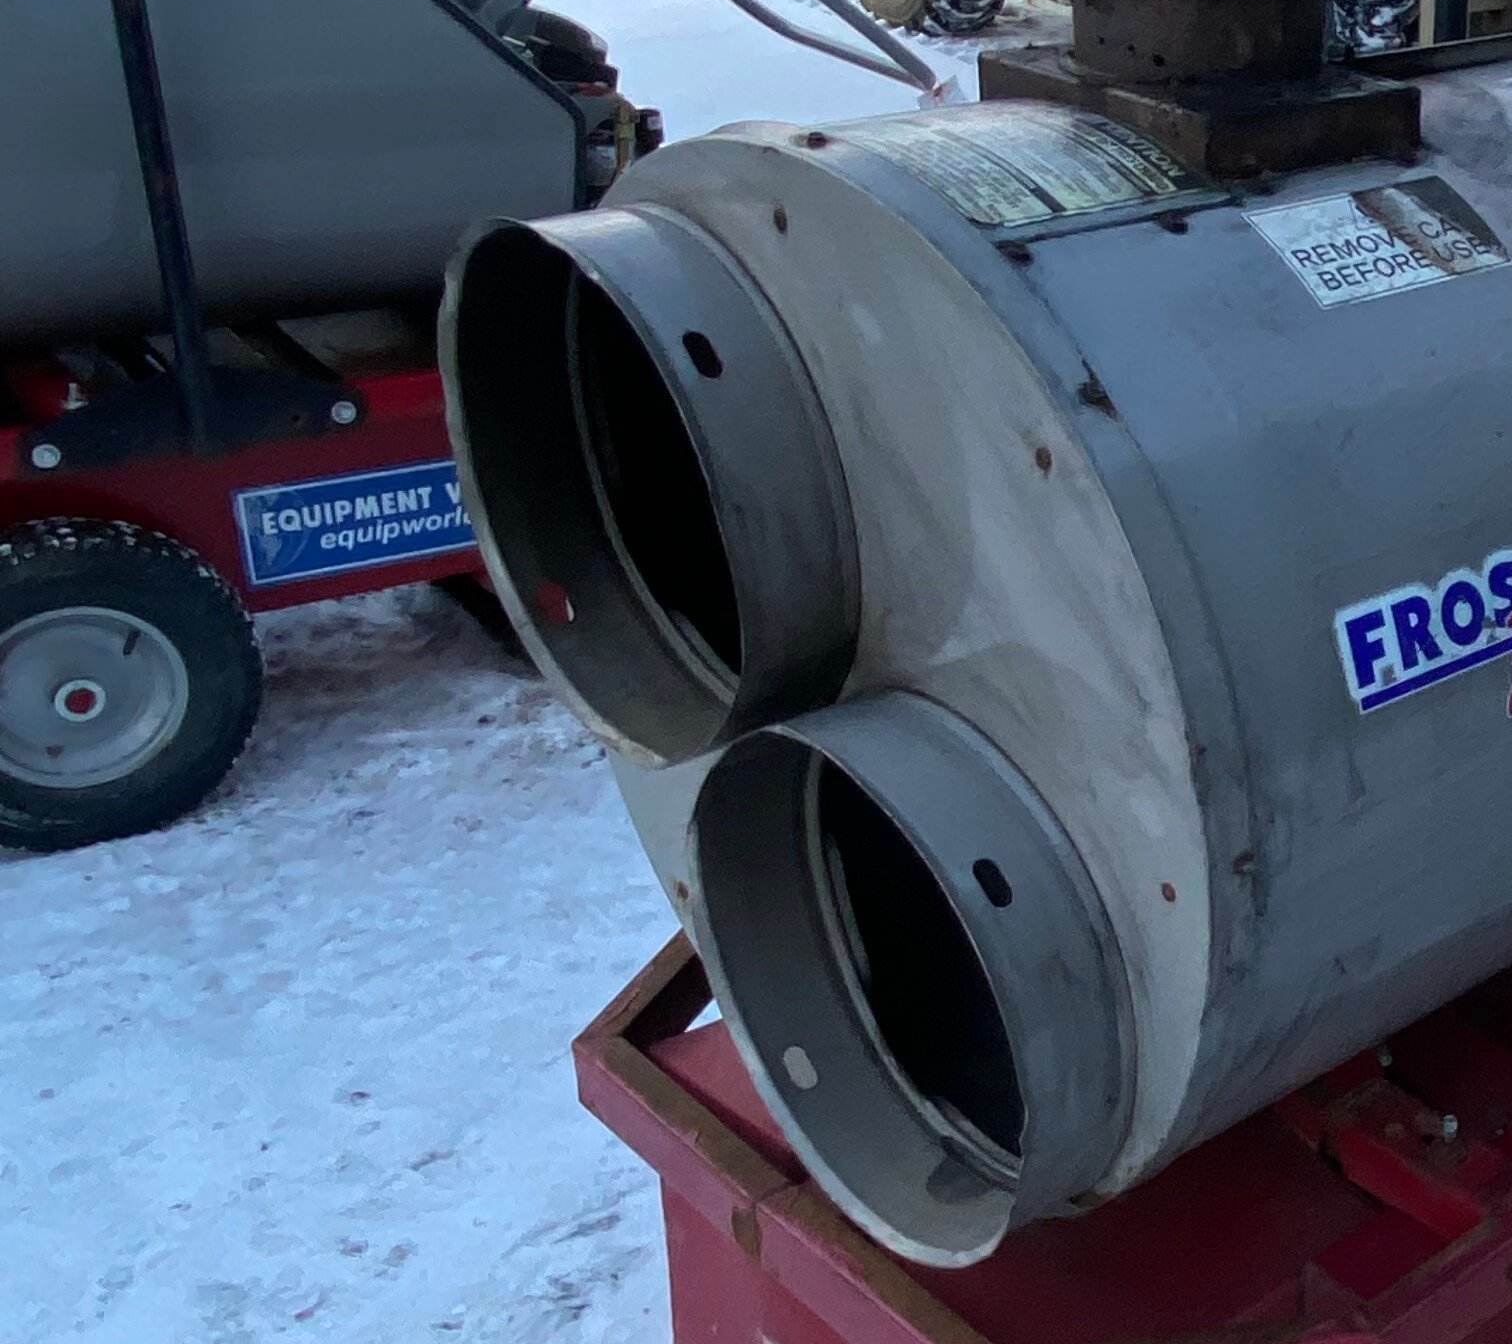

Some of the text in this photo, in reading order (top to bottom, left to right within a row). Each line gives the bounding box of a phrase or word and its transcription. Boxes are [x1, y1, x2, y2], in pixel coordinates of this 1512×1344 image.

[1317, 234, 1492, 292] BEFORE USE
[261, 487, 432, 534] EQUIPMENT
